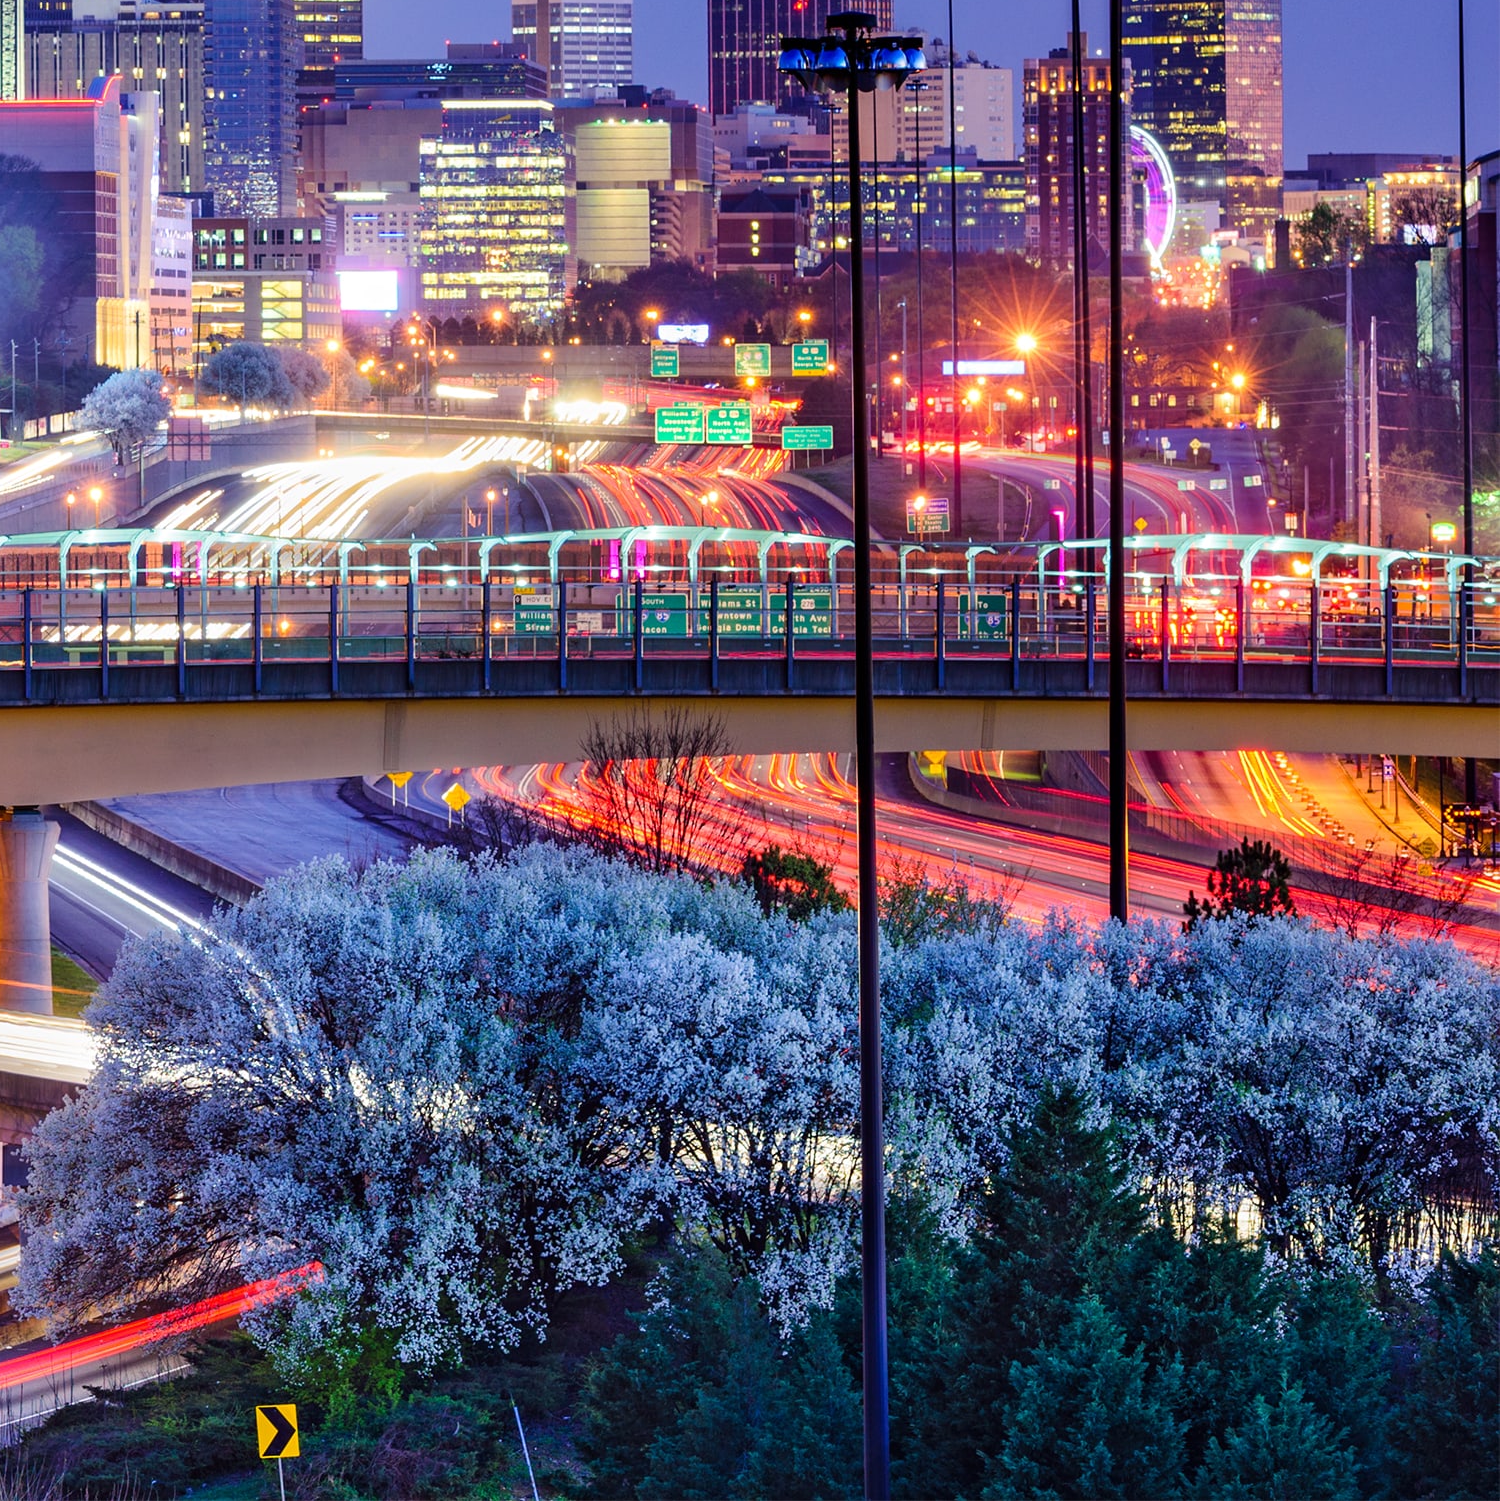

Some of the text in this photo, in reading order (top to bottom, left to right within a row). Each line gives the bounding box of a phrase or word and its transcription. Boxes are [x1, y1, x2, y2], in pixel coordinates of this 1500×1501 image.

[745, 599, 756, 607] St
[978, 601, 989, 609] To
[809, 614, 827, 622] Ave
[988, 616, 1000, 625] 85
